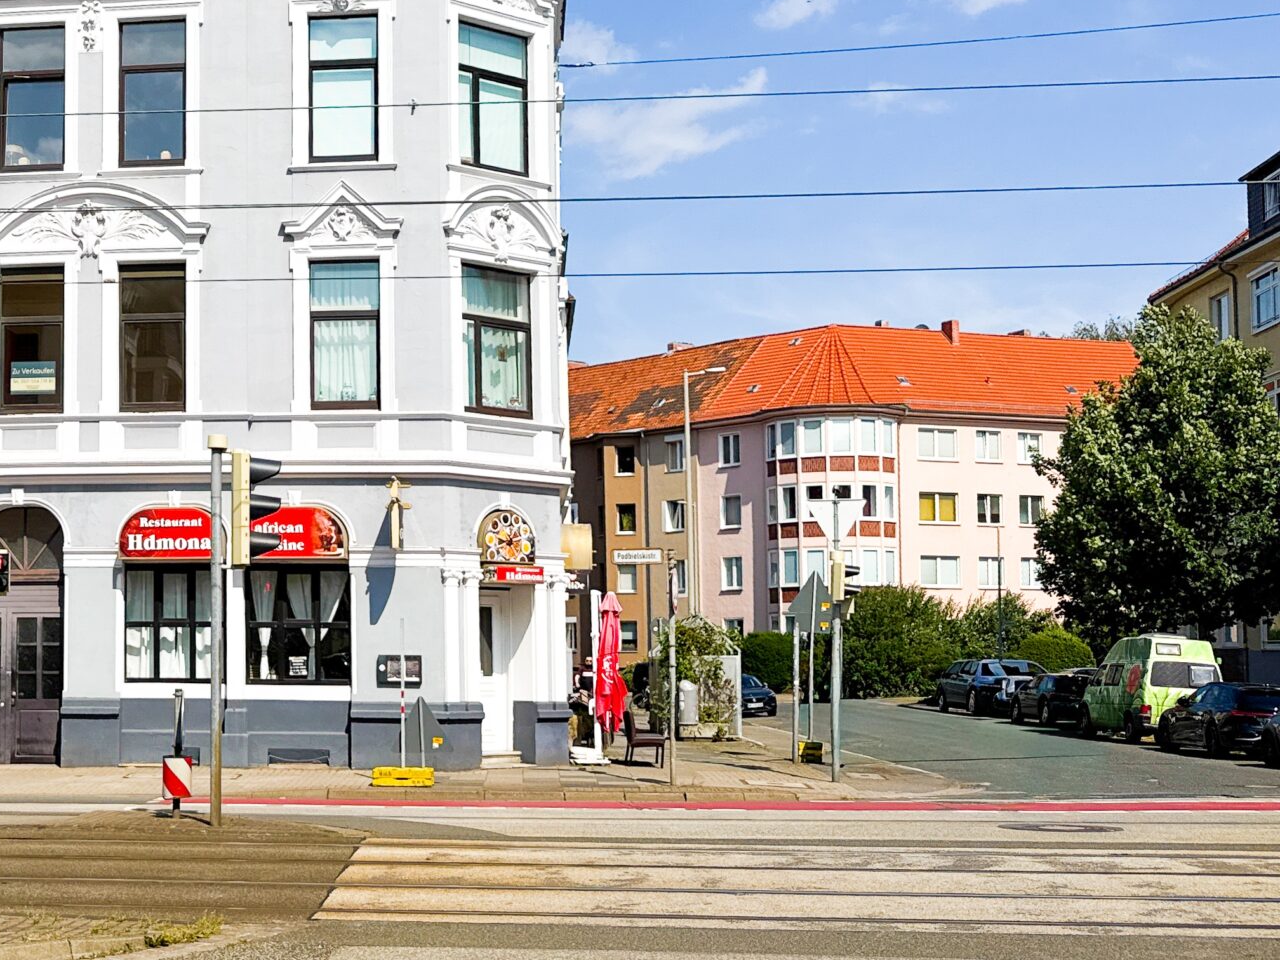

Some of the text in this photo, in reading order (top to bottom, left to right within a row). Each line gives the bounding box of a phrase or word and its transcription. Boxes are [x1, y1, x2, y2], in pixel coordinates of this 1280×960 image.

[140, 517, 203, 528] Restaurant
[254, 522, 304, 534] african
[127, 534, 212, 551] Hdmona
